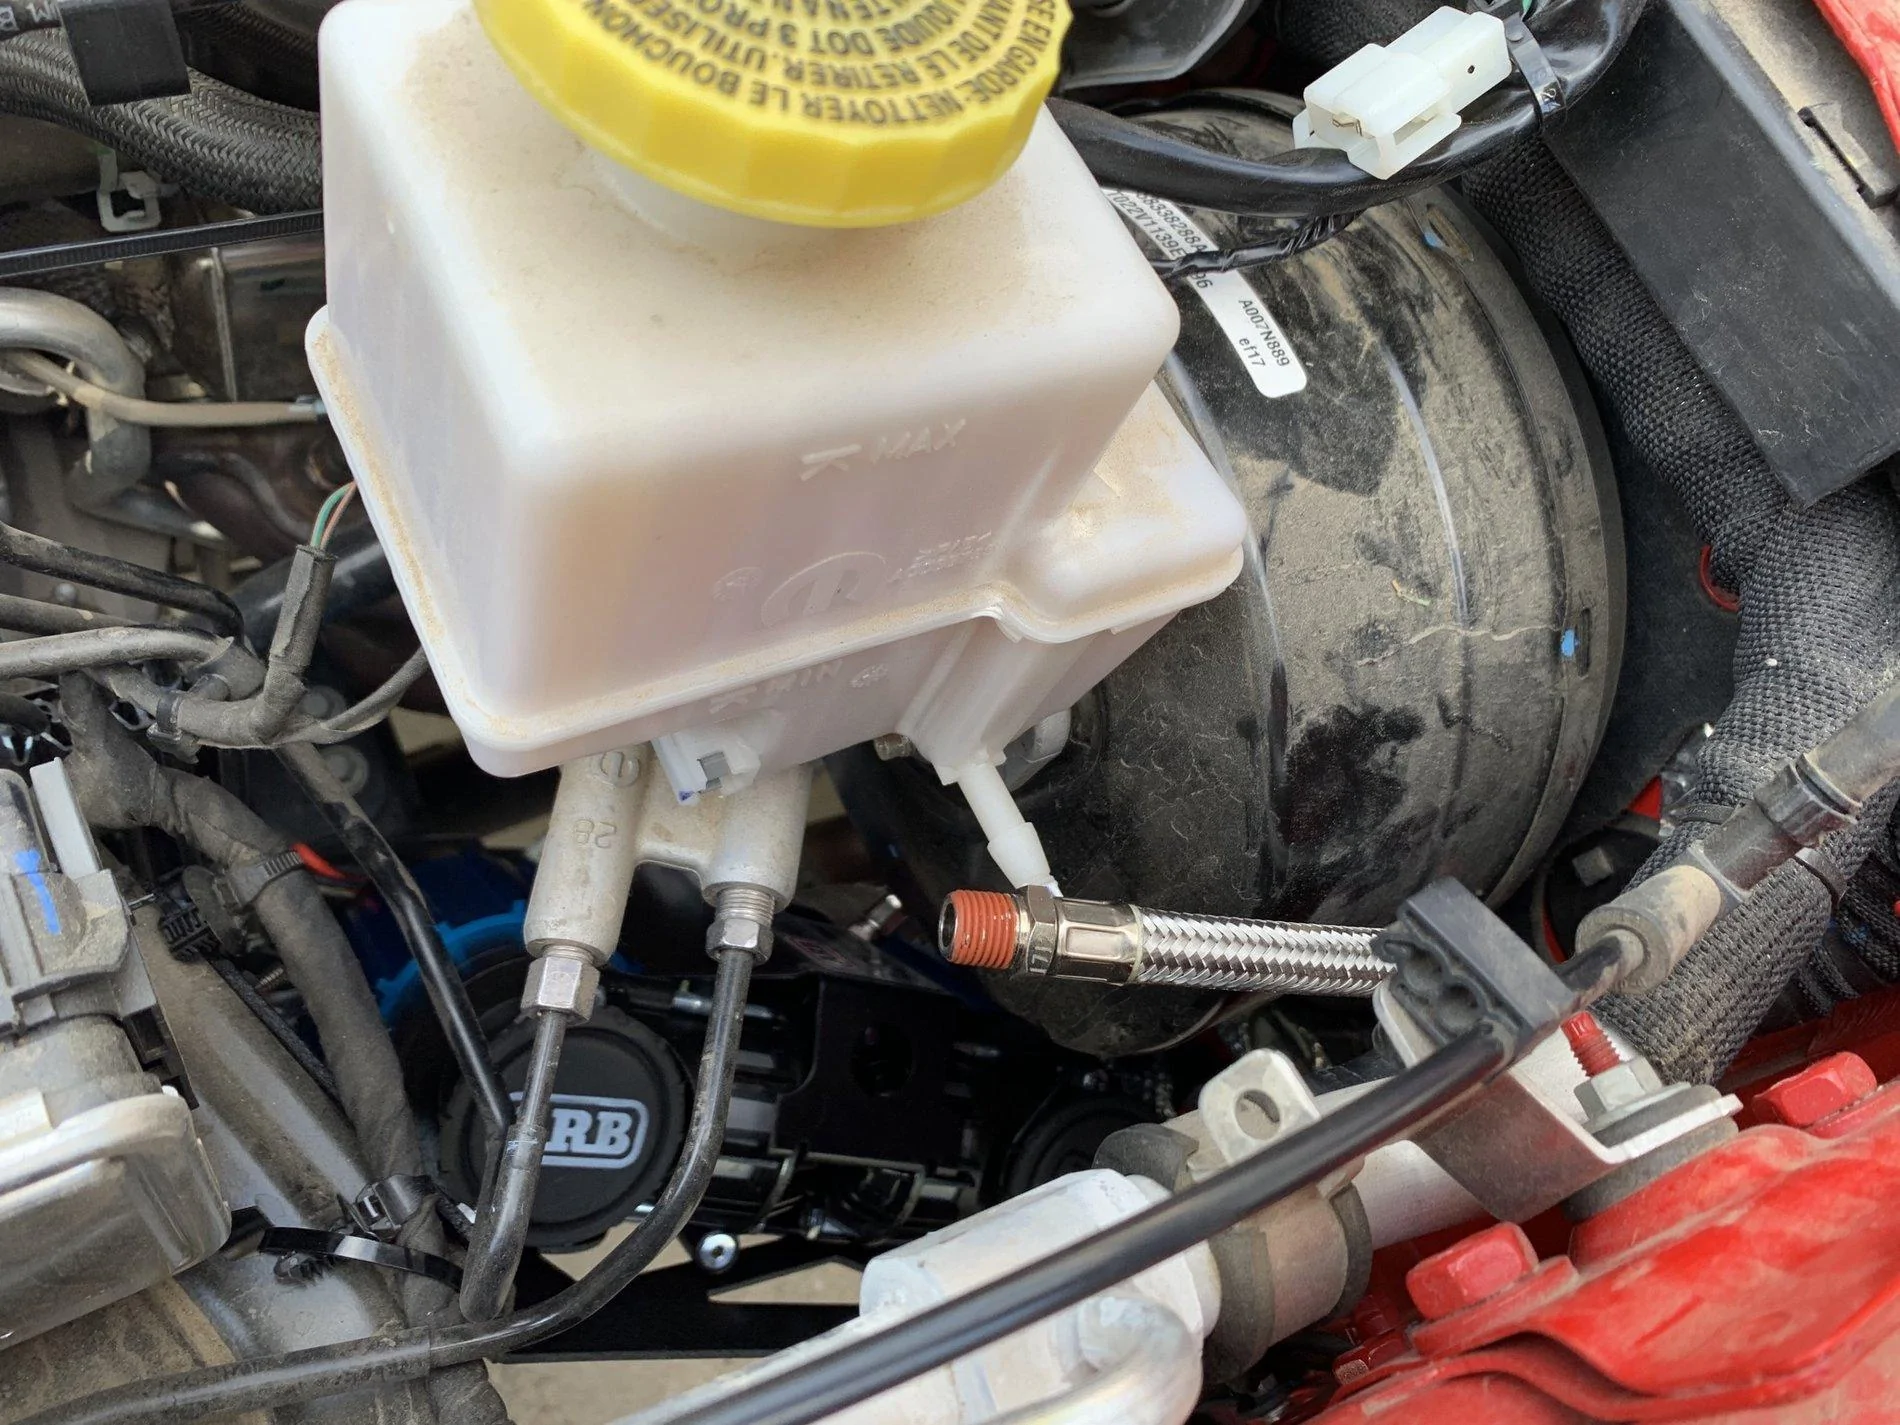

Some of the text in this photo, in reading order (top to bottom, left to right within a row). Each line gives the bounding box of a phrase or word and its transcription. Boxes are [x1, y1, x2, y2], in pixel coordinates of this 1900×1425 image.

[627, 0, 767, 72] UTILISE
[778, 22, 798, 48] 3
[808, 28, 875, 57] DOT
[947, 31, 991, 62] DE
[1016, 18, 1051, 53] EN
[915, 49, 961, 79] LE
[748, 79, 791, 112] LE
[801, 88, 963, 125] NETTOYER
[1238, 299, 1291, 368] A007N889
[1239, 337, 1267, 368] ef17
[546, 1107, 634, 1157] RB
